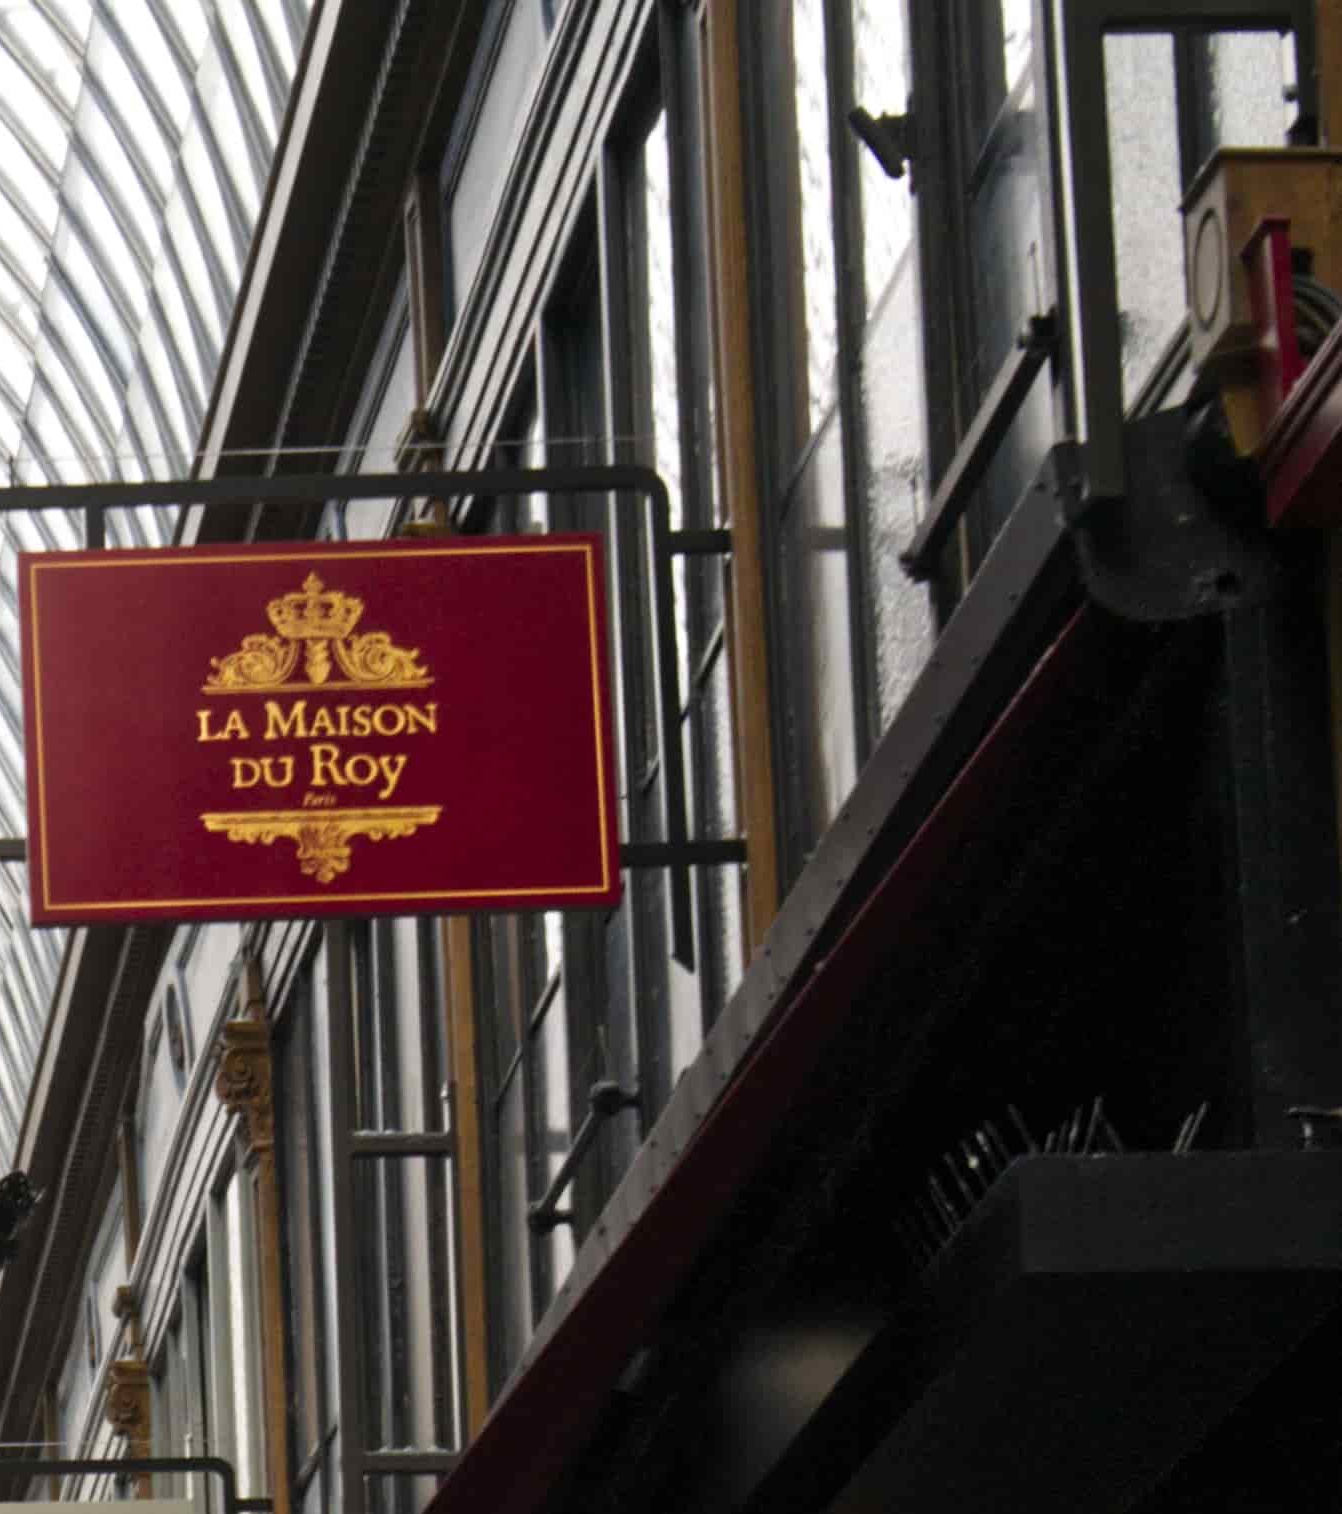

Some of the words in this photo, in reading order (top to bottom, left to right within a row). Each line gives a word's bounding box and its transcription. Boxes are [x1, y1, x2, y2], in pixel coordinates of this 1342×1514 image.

[196, 708, 251, 743] LA
[263, 699, 438, 741] MAISON
[230, 755, 296, 789] DU
